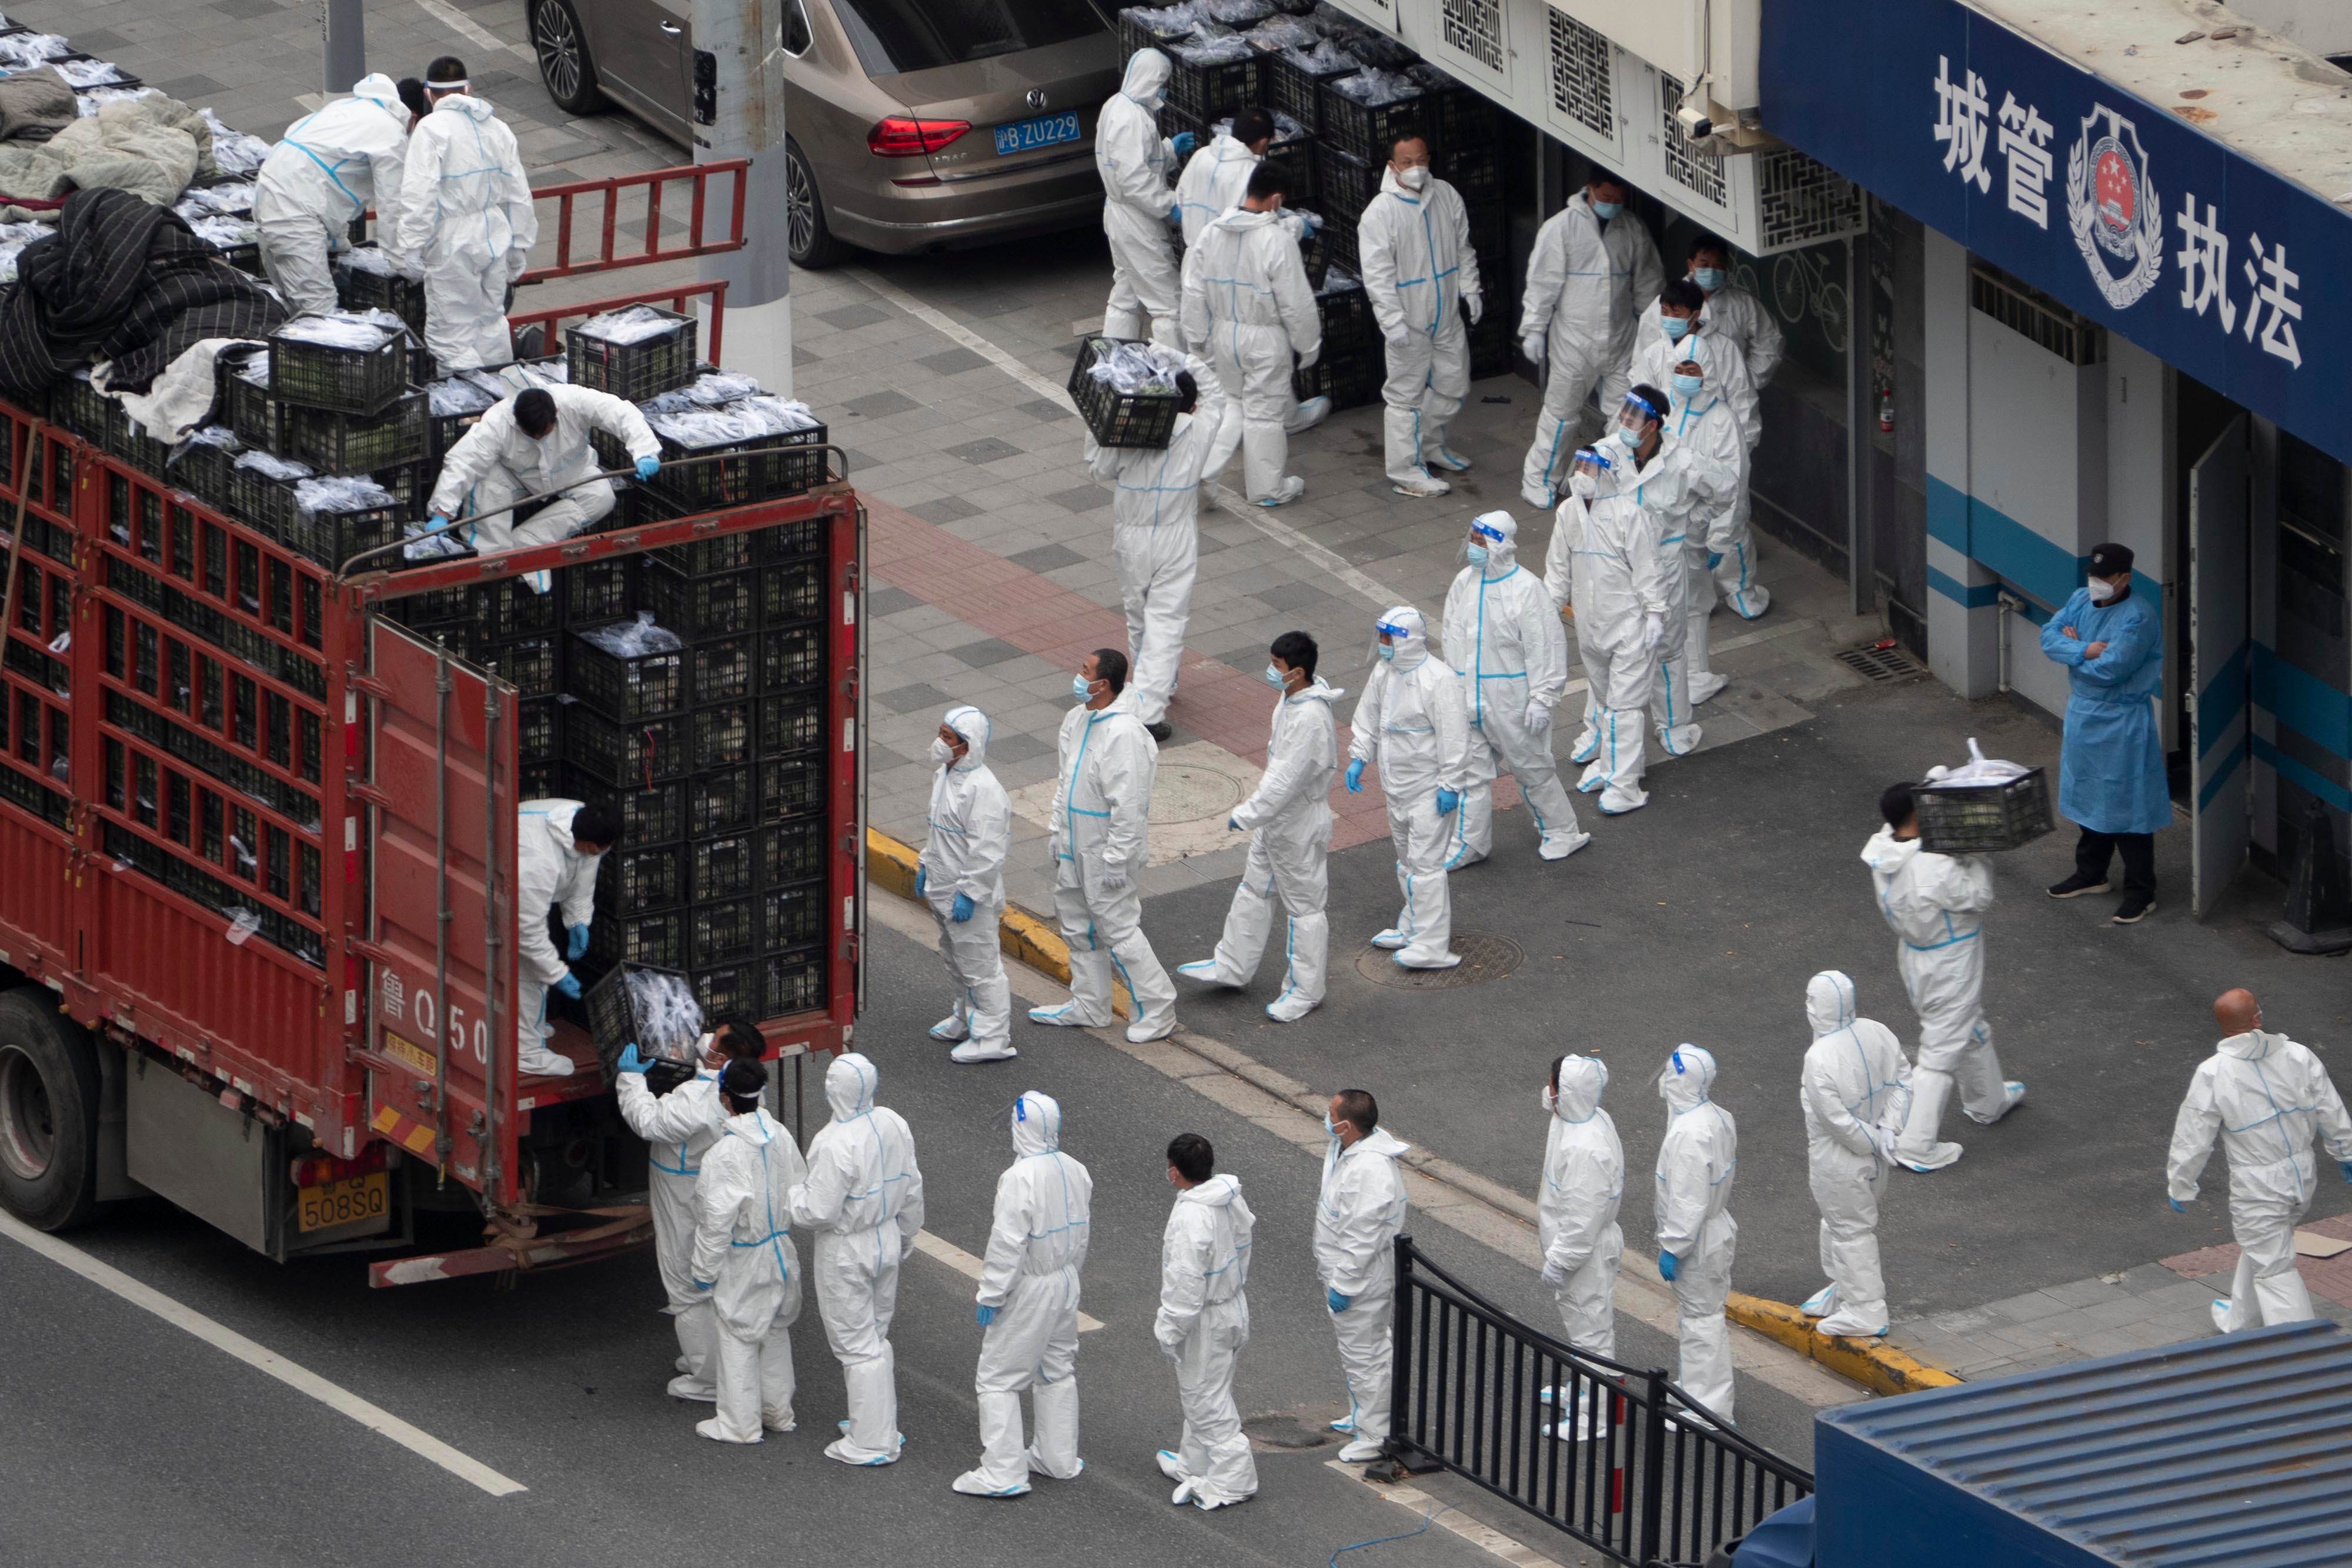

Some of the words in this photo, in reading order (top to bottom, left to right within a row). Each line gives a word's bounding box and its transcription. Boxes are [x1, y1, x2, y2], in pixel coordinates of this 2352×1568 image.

[1934, 55, 2053, 230] 城管
[2177, 192, 2301, 370] 执法
[305, 1188, 382, 1226] 508SQ
